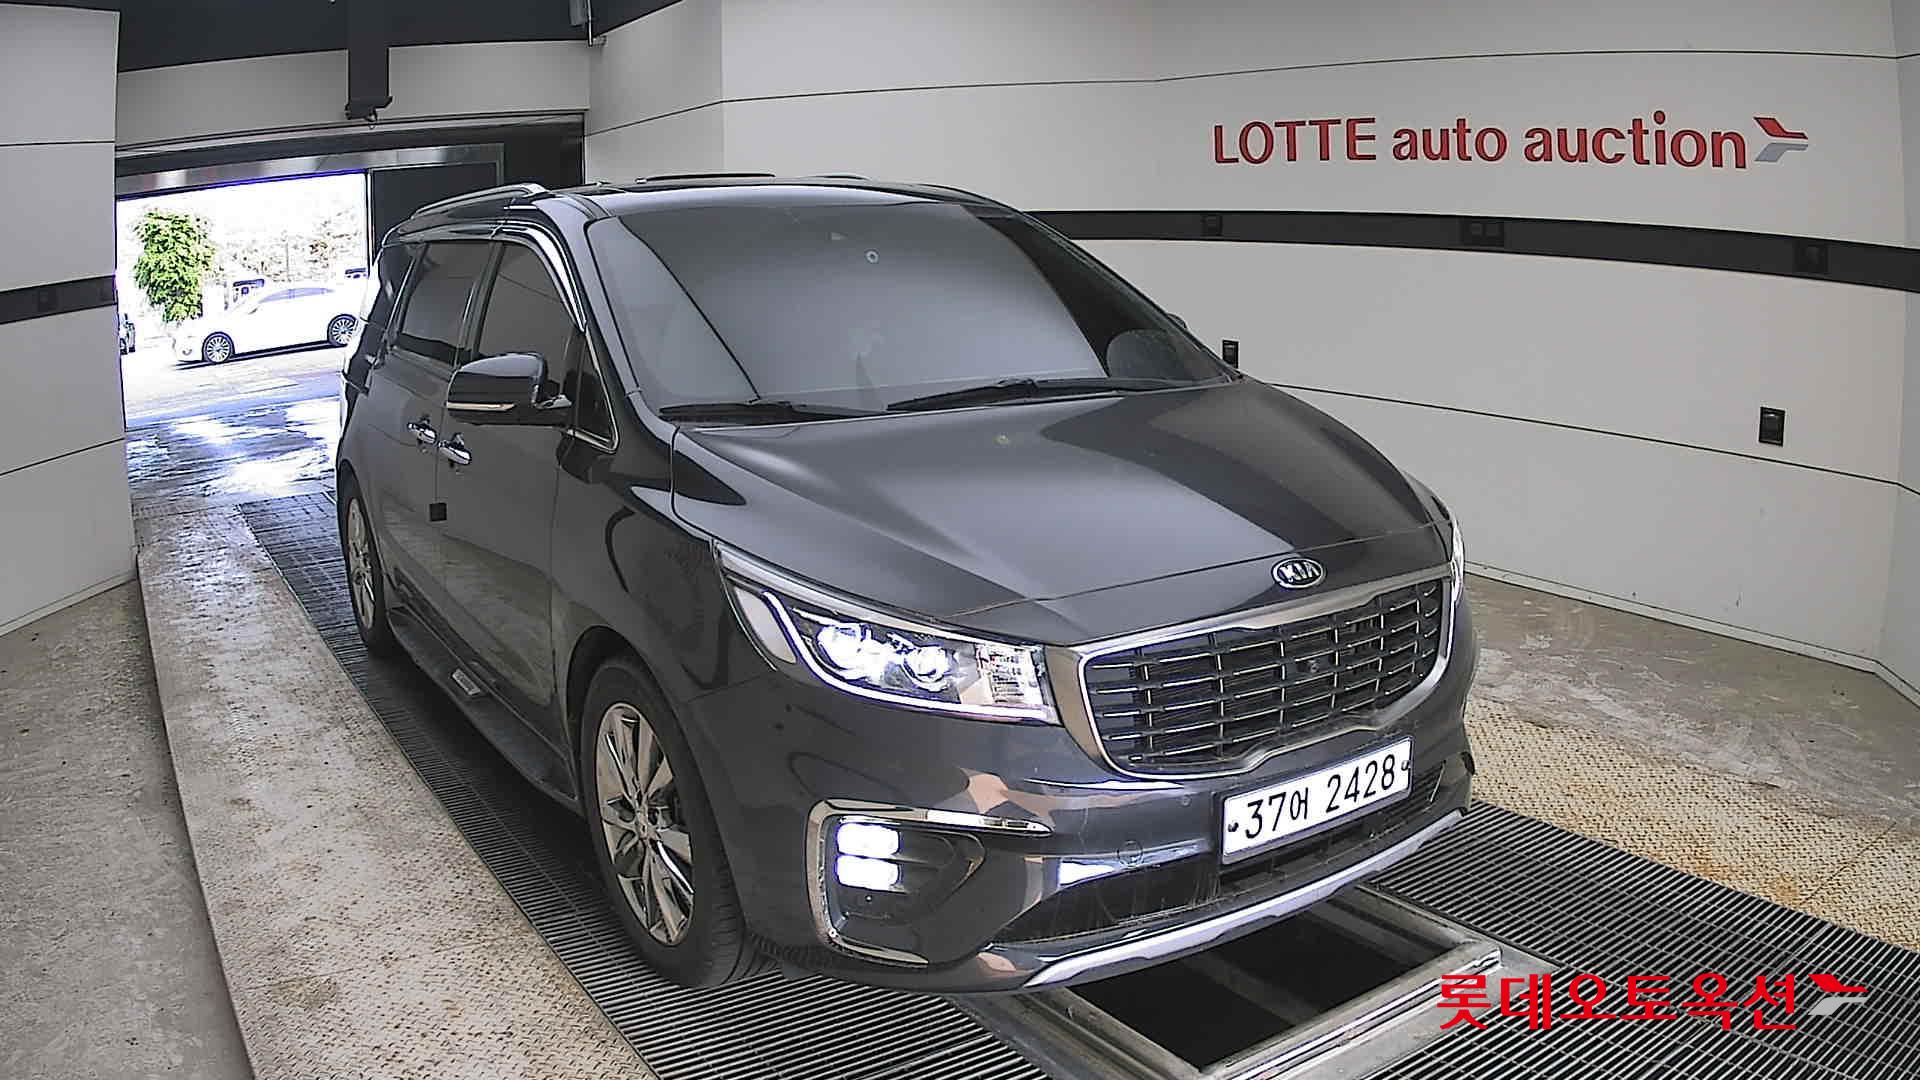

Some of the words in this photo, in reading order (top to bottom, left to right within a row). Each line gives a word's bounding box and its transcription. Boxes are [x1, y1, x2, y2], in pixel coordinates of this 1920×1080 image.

[1214, 117, 1377, 164] LOTTE
[1392, 118, 1509, 162] auto
[1523, 110, 1747, 169] auction
[1279, 561, 1320, 583] KIA
[1244, 786, 1309, 839] 37어
[1324, 753, 1396, 814] 2428
